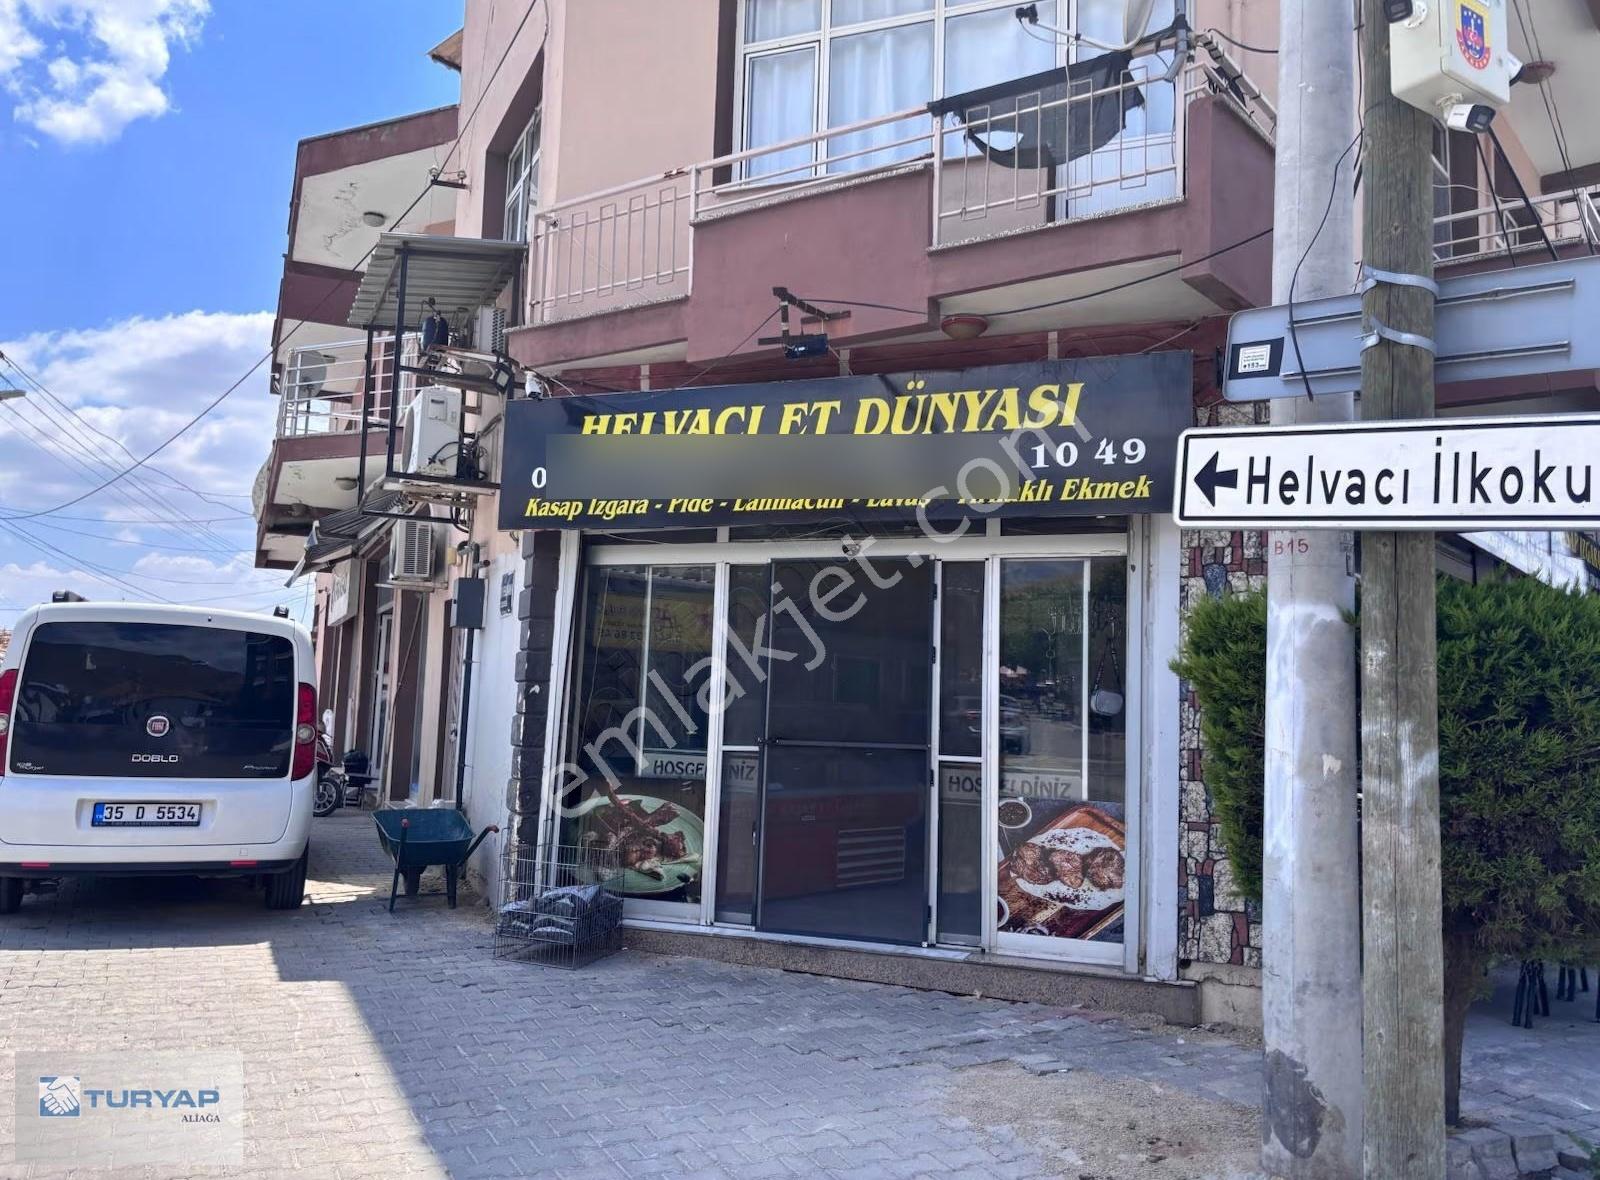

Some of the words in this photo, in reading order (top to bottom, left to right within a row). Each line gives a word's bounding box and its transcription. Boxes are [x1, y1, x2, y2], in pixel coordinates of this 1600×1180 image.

[779, 400, 841, 434] ET
[854, 380, 1085, 434] DÜNYASI
[1031, 441, 1079, 469] 10
[1094, 437, 1146, 467] 49
[525, 498, 583, 521] Kasap
[1060, 475, 1153, 501] Ekmek
[1247, 455, 1409, 506] Helvacı
[131, 754, 179, 763] DOBLO
[104, 806, 125, 820] 35
[135, 806, 145, 820] D
[156, 806, 196, 820] 5534
